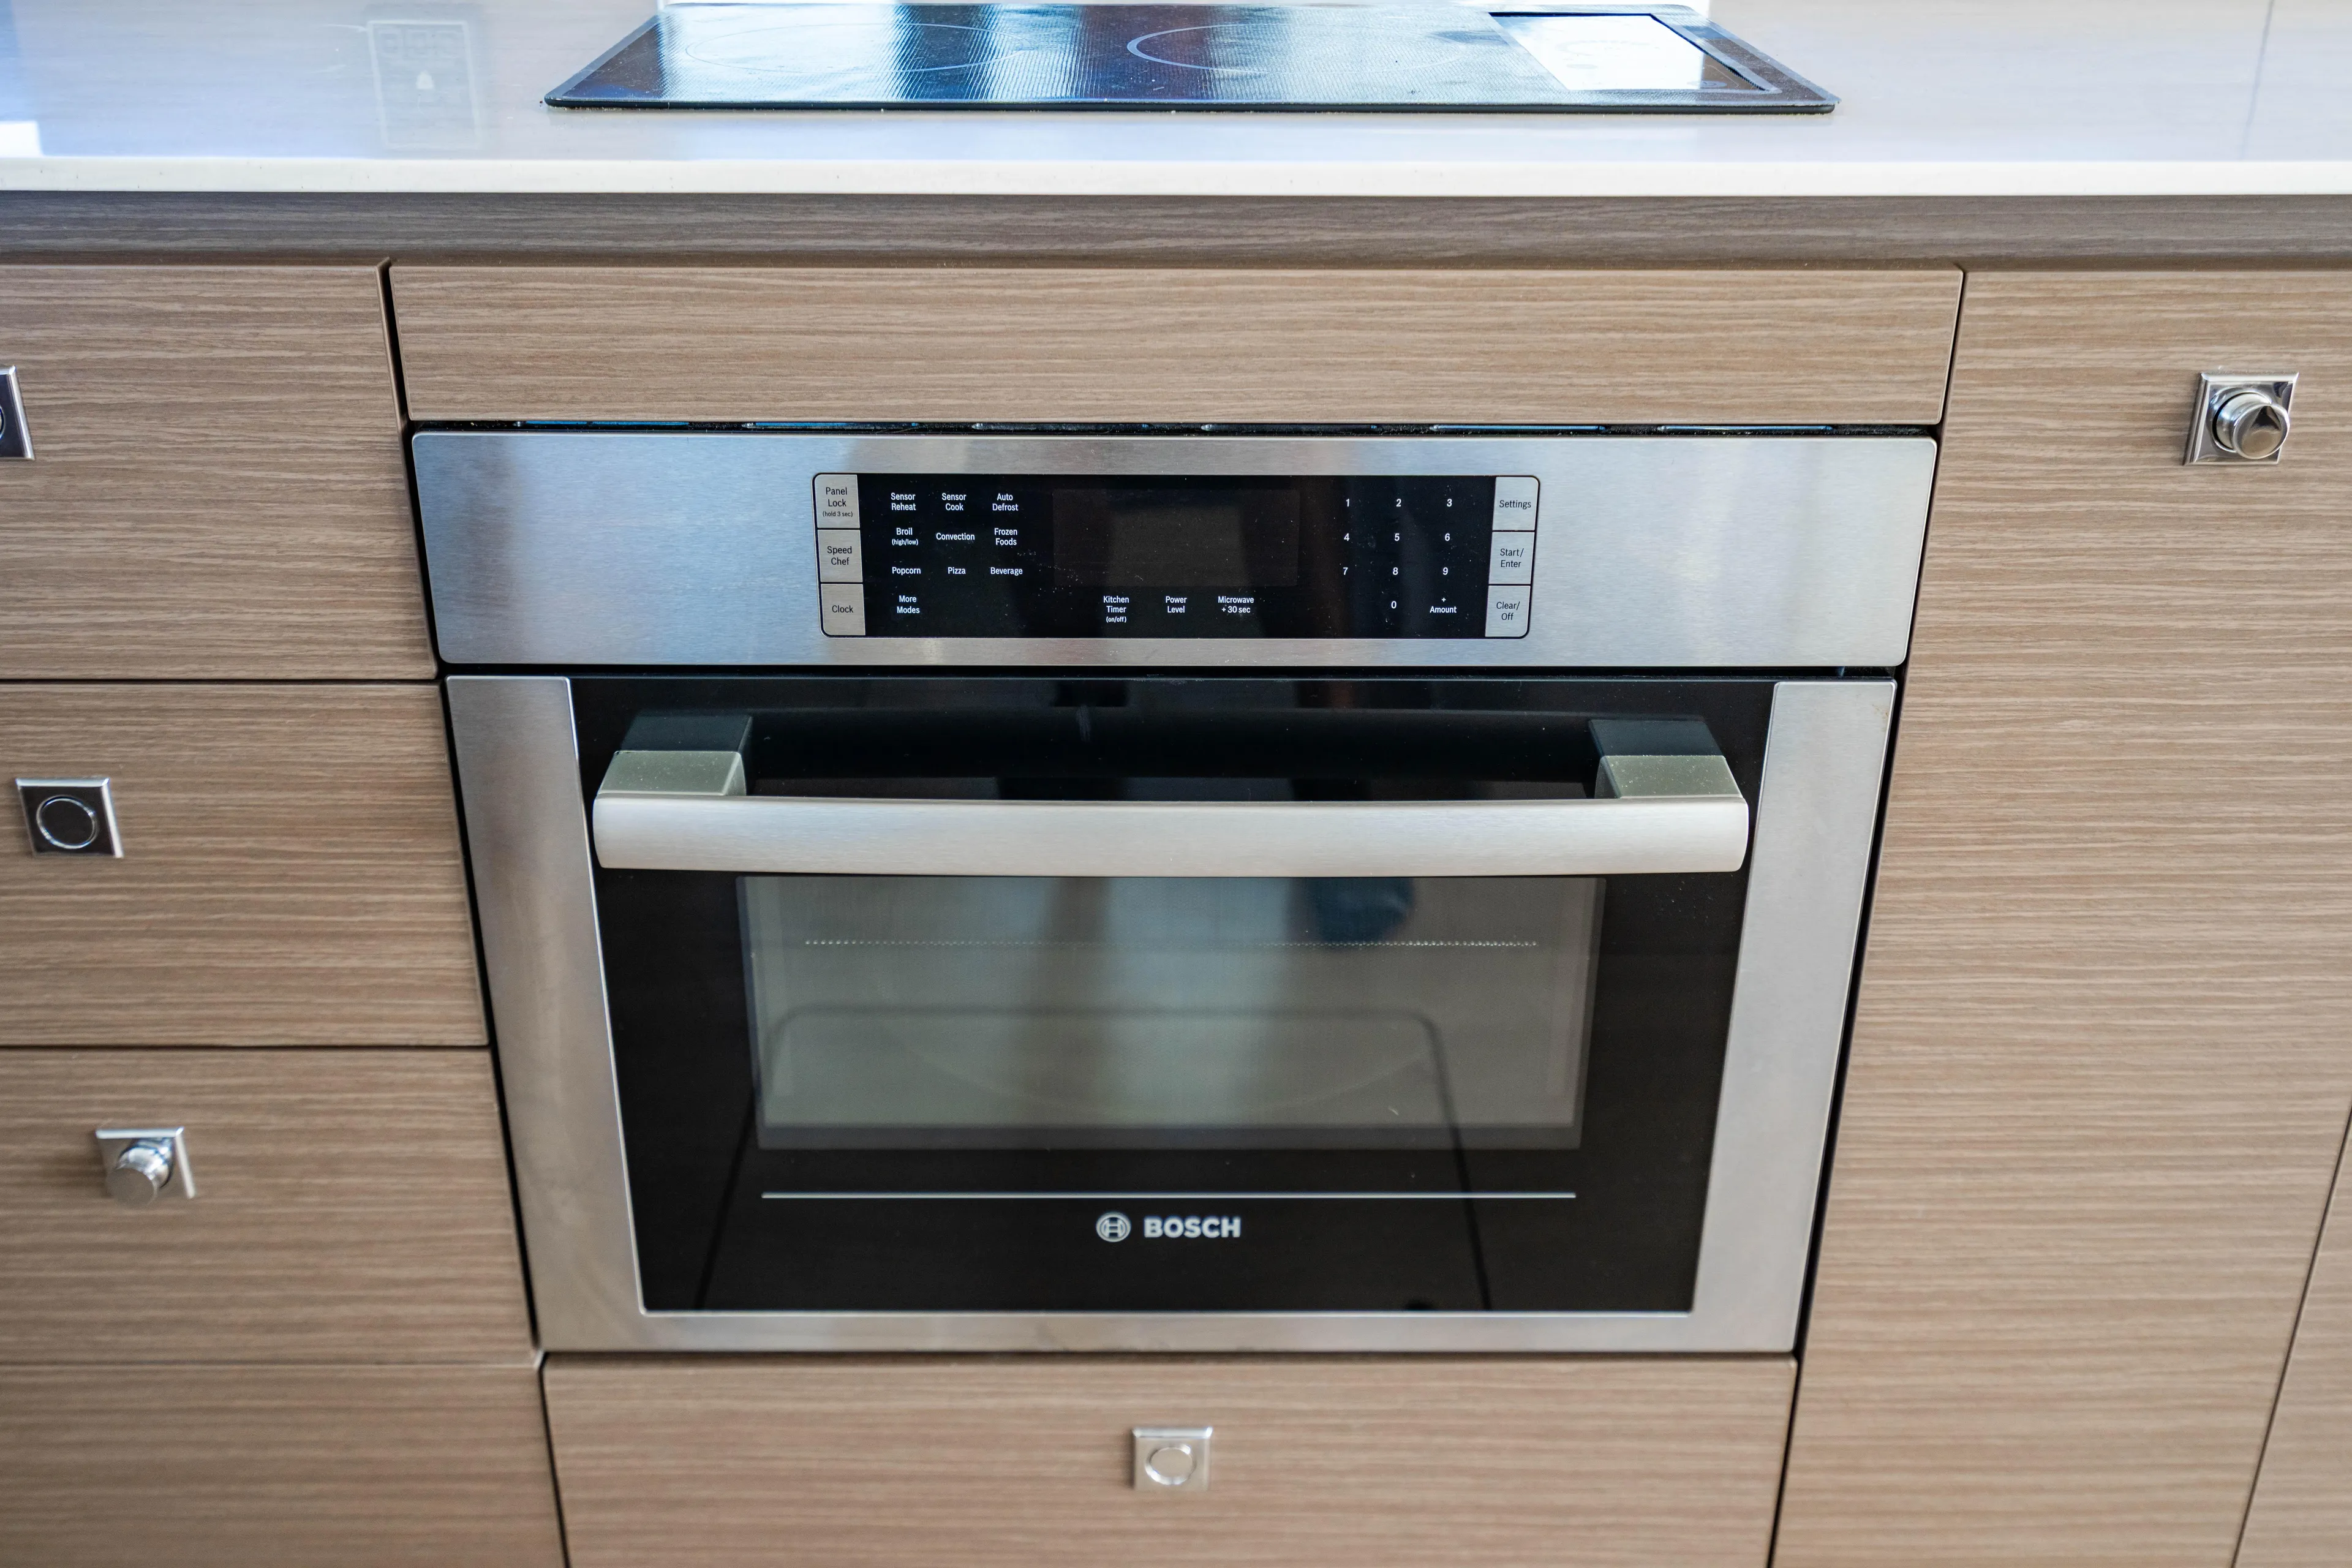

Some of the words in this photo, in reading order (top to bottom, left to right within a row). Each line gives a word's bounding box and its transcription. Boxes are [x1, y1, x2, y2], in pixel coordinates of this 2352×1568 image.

[826, 486, 848, 496] Panel
[891, 492, 916, 500] Sensor
[941, 492, 967, 501] Sensor
[997, 492, 1014, 501] Auto
[827, 498, 847, 507] Lock
[891, 502, 916, 511] Reheat
[945, 502, 964, 511] Cook
[992, 503, 1019, 511] Defrost
[1346, 498, 1350, 507] 1
[1396, 498, 1401, 507] 2
[1446, 498, 1452, 507] 3
[1499, 499, 1531, 510] Settings
[896, 527, 913, 535] Broil
[936, 532, 975, 541] Convection
[1343, 533, 1350, 541] 4
[1394, 533, 1400, 541] 5
[1444, 533, 1450, 541] 6
[995, 537, 1017, 546] Foods
[827, 545, 853, 556] Speed
[1499, 548, 1525, 558] Start/
[831, 557, 850, 565] Chef
[1500, 559, 1521, 568] Enter
[892, 567, 921, 576] Popcorn
[990, 567, 1023, 576] Beverage
[1343, 567, 1348, 575] 7
[1392, 567, 1398, 576] 8
[1442, 567, 1449, 576] 9
[831, 605, 854, 613] Clock
[1390, 600, 1397, 609] 0
[1496, 601, 1521, 611] Clear/
[1501, 612, 1514, 620] Off
[1144, 1216, 1241, 1238] BOSCH
